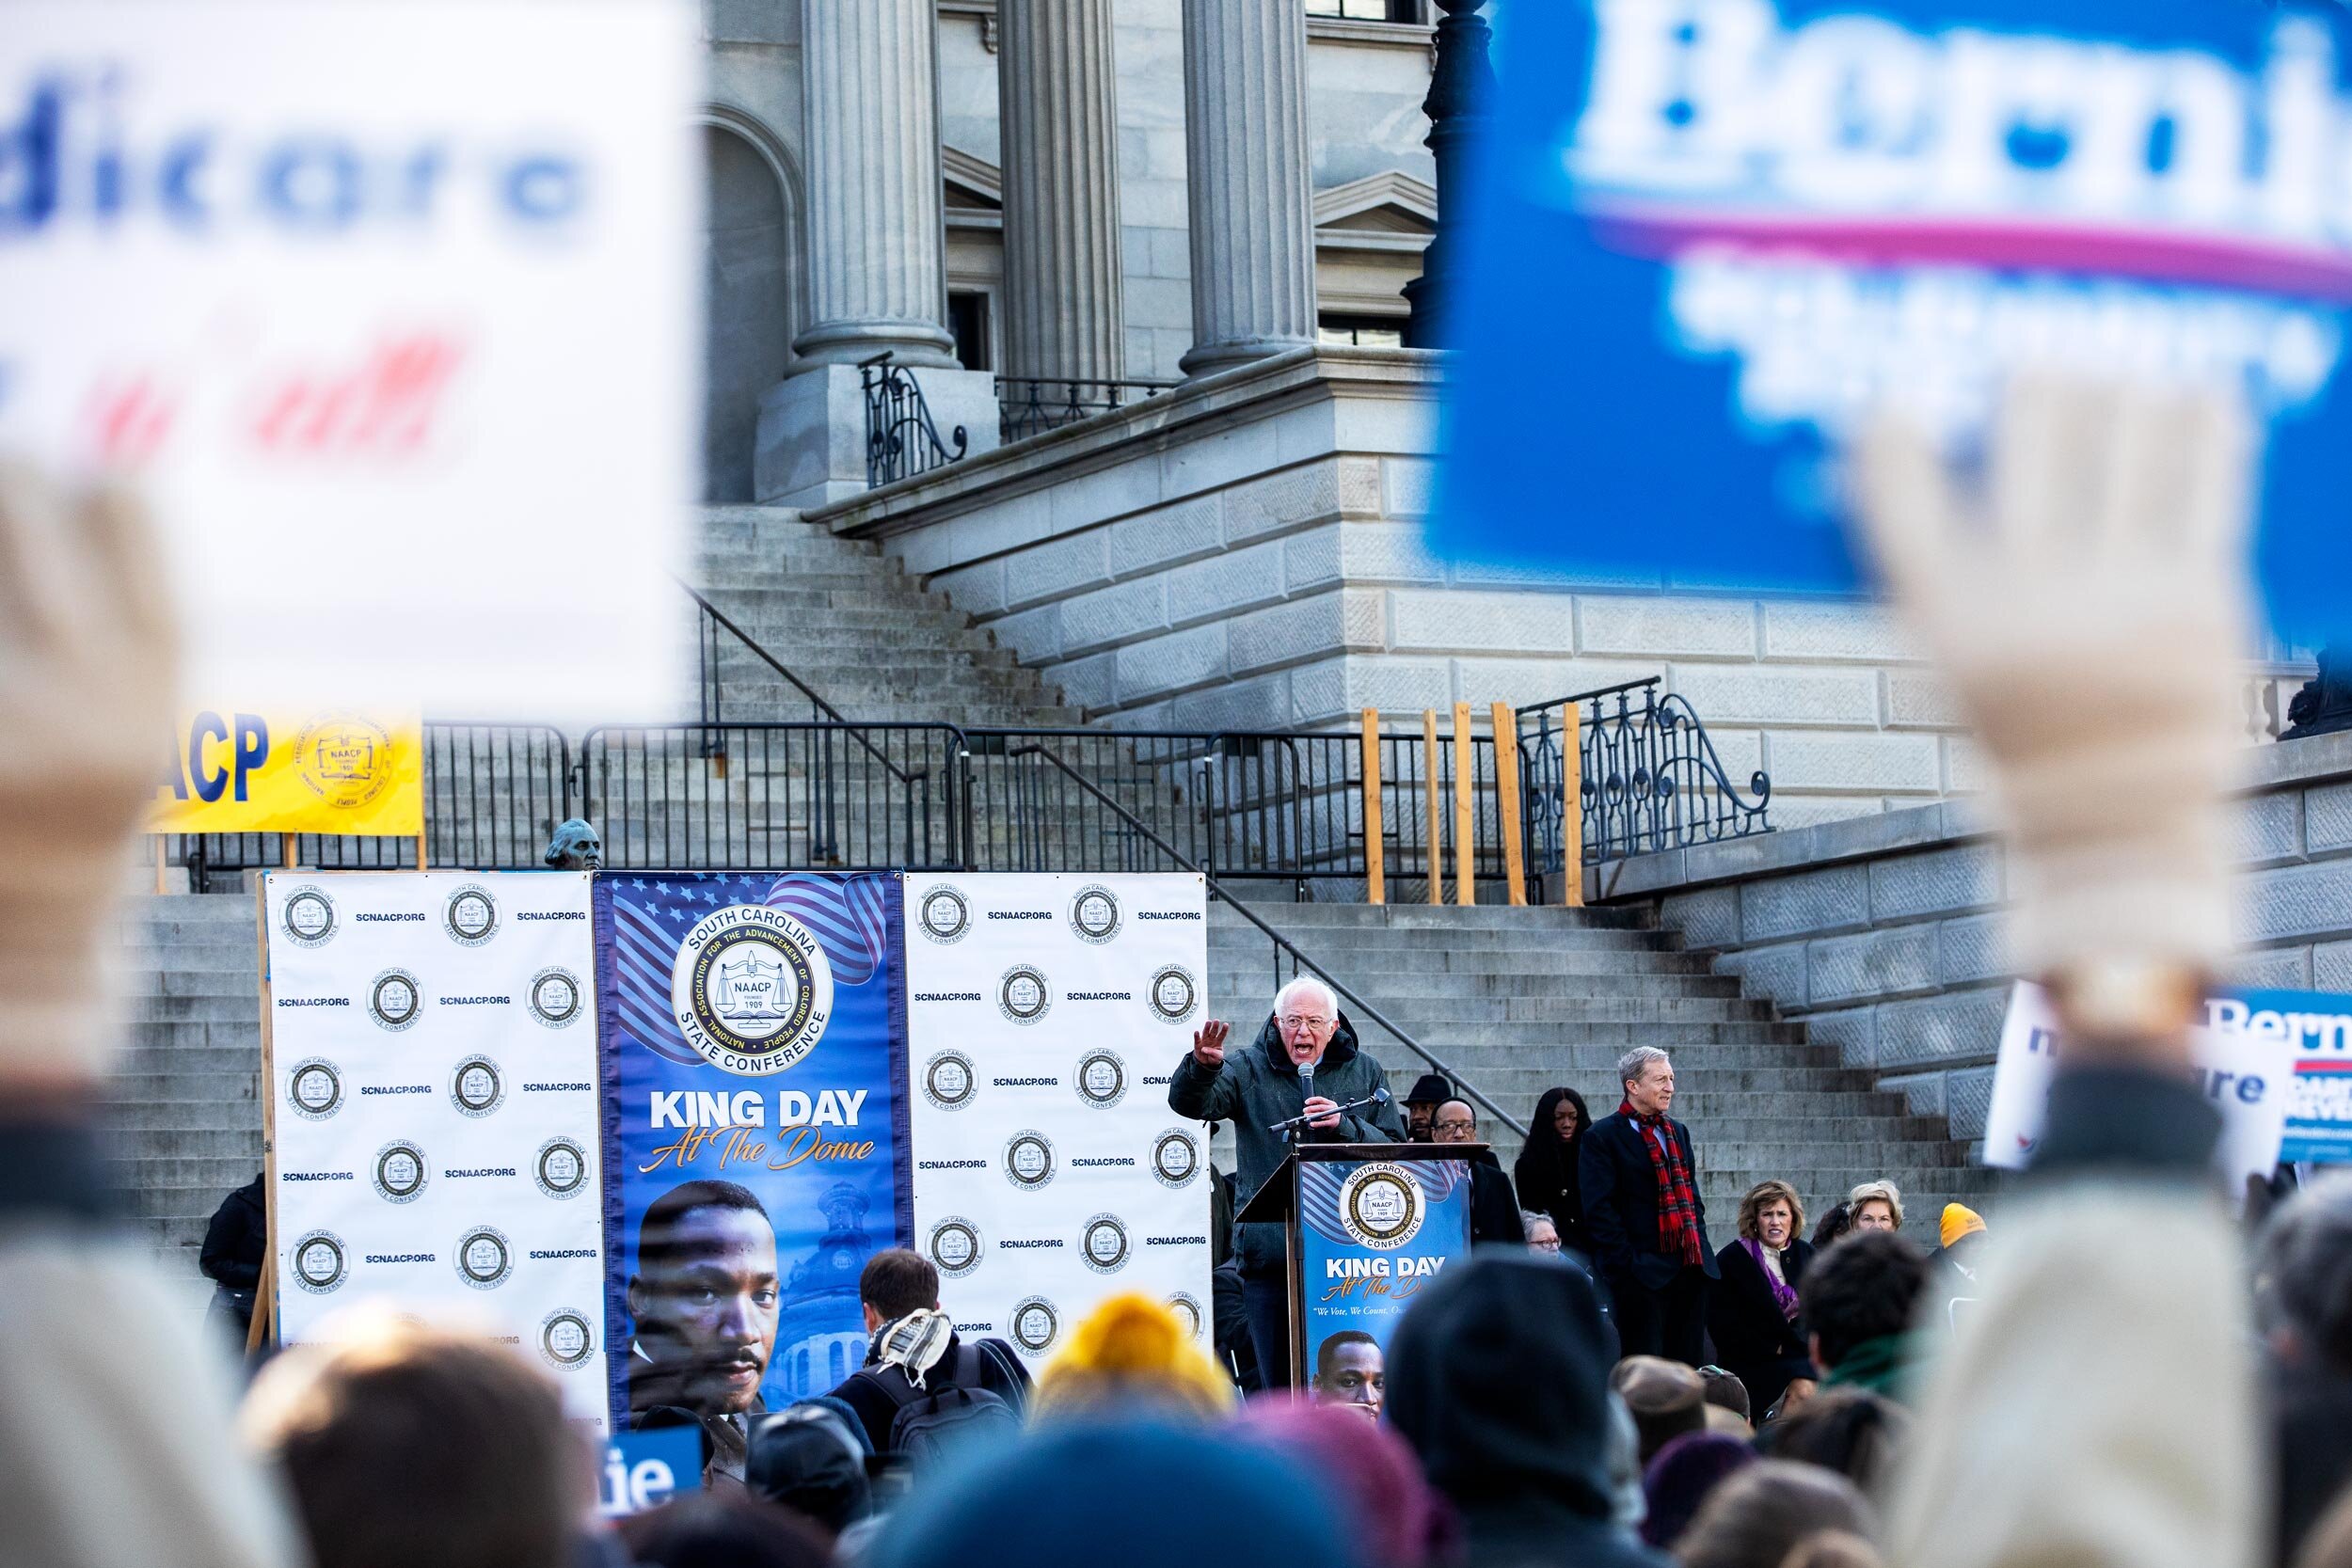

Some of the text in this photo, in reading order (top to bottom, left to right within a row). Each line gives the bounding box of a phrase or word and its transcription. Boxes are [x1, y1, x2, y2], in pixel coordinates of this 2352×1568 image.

[284, 887, 334, 904] SOUTH CAROLINA
[448, 885, 496, 903] SOUTH CAROLINA
[922, 885, 968, 902] SOUTH CAROLINA
[1073, 885, 1119, 902] SOUTH CAROLINA
[357, 912, 424, 922] SCNAACP.ORG
[517, 912, 585, 921] SCNAACP.ORG
[282, 925, 338, 947] STATE CONFERENCE
[445, 923, 499, 946] STATE CONFERENCE
[689, 909, 816, 957] SOUTH CAROLINA
[919, 922, 971, 943] STATE CONFERENCE
[1072, 922, 1121, 943] STATE CONFERENCE
[373, 969, 420, 987] SOUTH CAROLINA
[532, 968, 580, 985] SOUTH CAROLINA
[1002, 966, 1047, 983] SOUTH CAROLINA
[1152, 965, 1195, 982] SOUTH CAROLINA
[696, 929, 809, 1050] NATIONAL ASSOCIATION FOR THE ADVANCEMENT OF COLORED PEOPLE
[735, 983, 771, 992] NAACP
[1068, 991, 1131, 1001] SCNAACP.ORG
[279, 997, 349, 1007] SCNAACP.ORG
[440, 995, 510, 1006] SCNAACP.ORG
[915, 993, 980, 1002] SCNAACP.ORG
[370, 1007, 421, 1031] STATE CONFERENCE
[529, 1006, 582, 1028] STATE CONFERENCE
[999, 1003, 1050, 1024] STATE CONFERENCE
[1150, 1002, 1197, 1023] STATE CONFERENCE
[681, 1011, 825, 1071] STATE CONFERENCE
[292, 1058, 342, 1076] SOUTH CAROLINA
[455, 1056, 501, 1073] SOUTH CAROLINA
[928, 1051, 975, 1068] SOUTH CAROLINA
[1079, 1050, 1123, 1067] SOUTH CAROLINA
[361, 1085, 431, 1095] SCNAACP.ORG
[524, 1084, 591, 1092] SCNAACP.ORG
[993, 1078, 1057, 1086] SCNAACP.ORG
[452, 1094, 502, 1117] STATE CONFERENCE
[924, 1087, 977, 1110] STATE CONFERENCE
[1076, 1086, 1126, 1108] STATE CONFERENCE
[288, 1097, 343, 1120] STATE CONFERENCE
[651, 1090, 868, 1128] KING DAY
[539, 1138, 585, 1155] SOUTH CAROLINA
[1008, 1132, 1052, 1148] SOUTH CAROLINA
[1155, 1130, 1198, 1146] SOUTH CAROLINA
[378, 1141, 425, 1159] SOUTH CAROLINA
[639, 1123, 876, 1173] At The Dome
[919, 1161, 986, 1170] SCNAACP.ORG
[1073, 1157, 1135, 1167] SCNAACP.ORG
[283, 1172, 353, 1181] SCNAACP.ORG
[445, 1168, 516, 1179] SCNAACP.ORG
[1005, 1168, 1055, 1190] STATE CONFERENCE
[1152, 1165, 1200, 1187] STATE CONFERENCE
[1347, 1164, 1417, 1189] SOUTH CAROLINA
[373, 1180, 427, 1202] STATE CONFERENCE
[535, 1176, 588, 1198] STATE CONFERENCE
[931, 1218, 978, 1235] SOUTH CAROLINA
[1084, 1214, 1127, 1231] SOUTH CAROLINA
[460, 1227, 508, 1244] SOUTH CAROLINA
[1147, 1236, 1205, 1245] SCNAACP.ORG
[1344, 1217, 1422, 1247] STATE CONFERENCE
[1000, 1240, 1063, 1249] SCNAACP.ORG
[366, 1253, 435, 1263] SCNAACP.ORG
[531, 1249, 596, 1259] SCNAACP.ORG
[1081, 1251, 1130, 1274] STATE CONFERENCE
[945, 1255, 981, 1276] CONFERENCE
[1327, 1257, 1445, 1278] KING DAY
[457, 1265, 512, 1289] STATE CONFERENCE
[1321, 1275, 1358, 1301] At
[1358, 1275, 1391, 1299] The
[1330, 1307, 1347, 1316] Vote,
[1350, 1307, 1360, 1315] We
[952, 1323, 992, 1332] ACP.ORG
